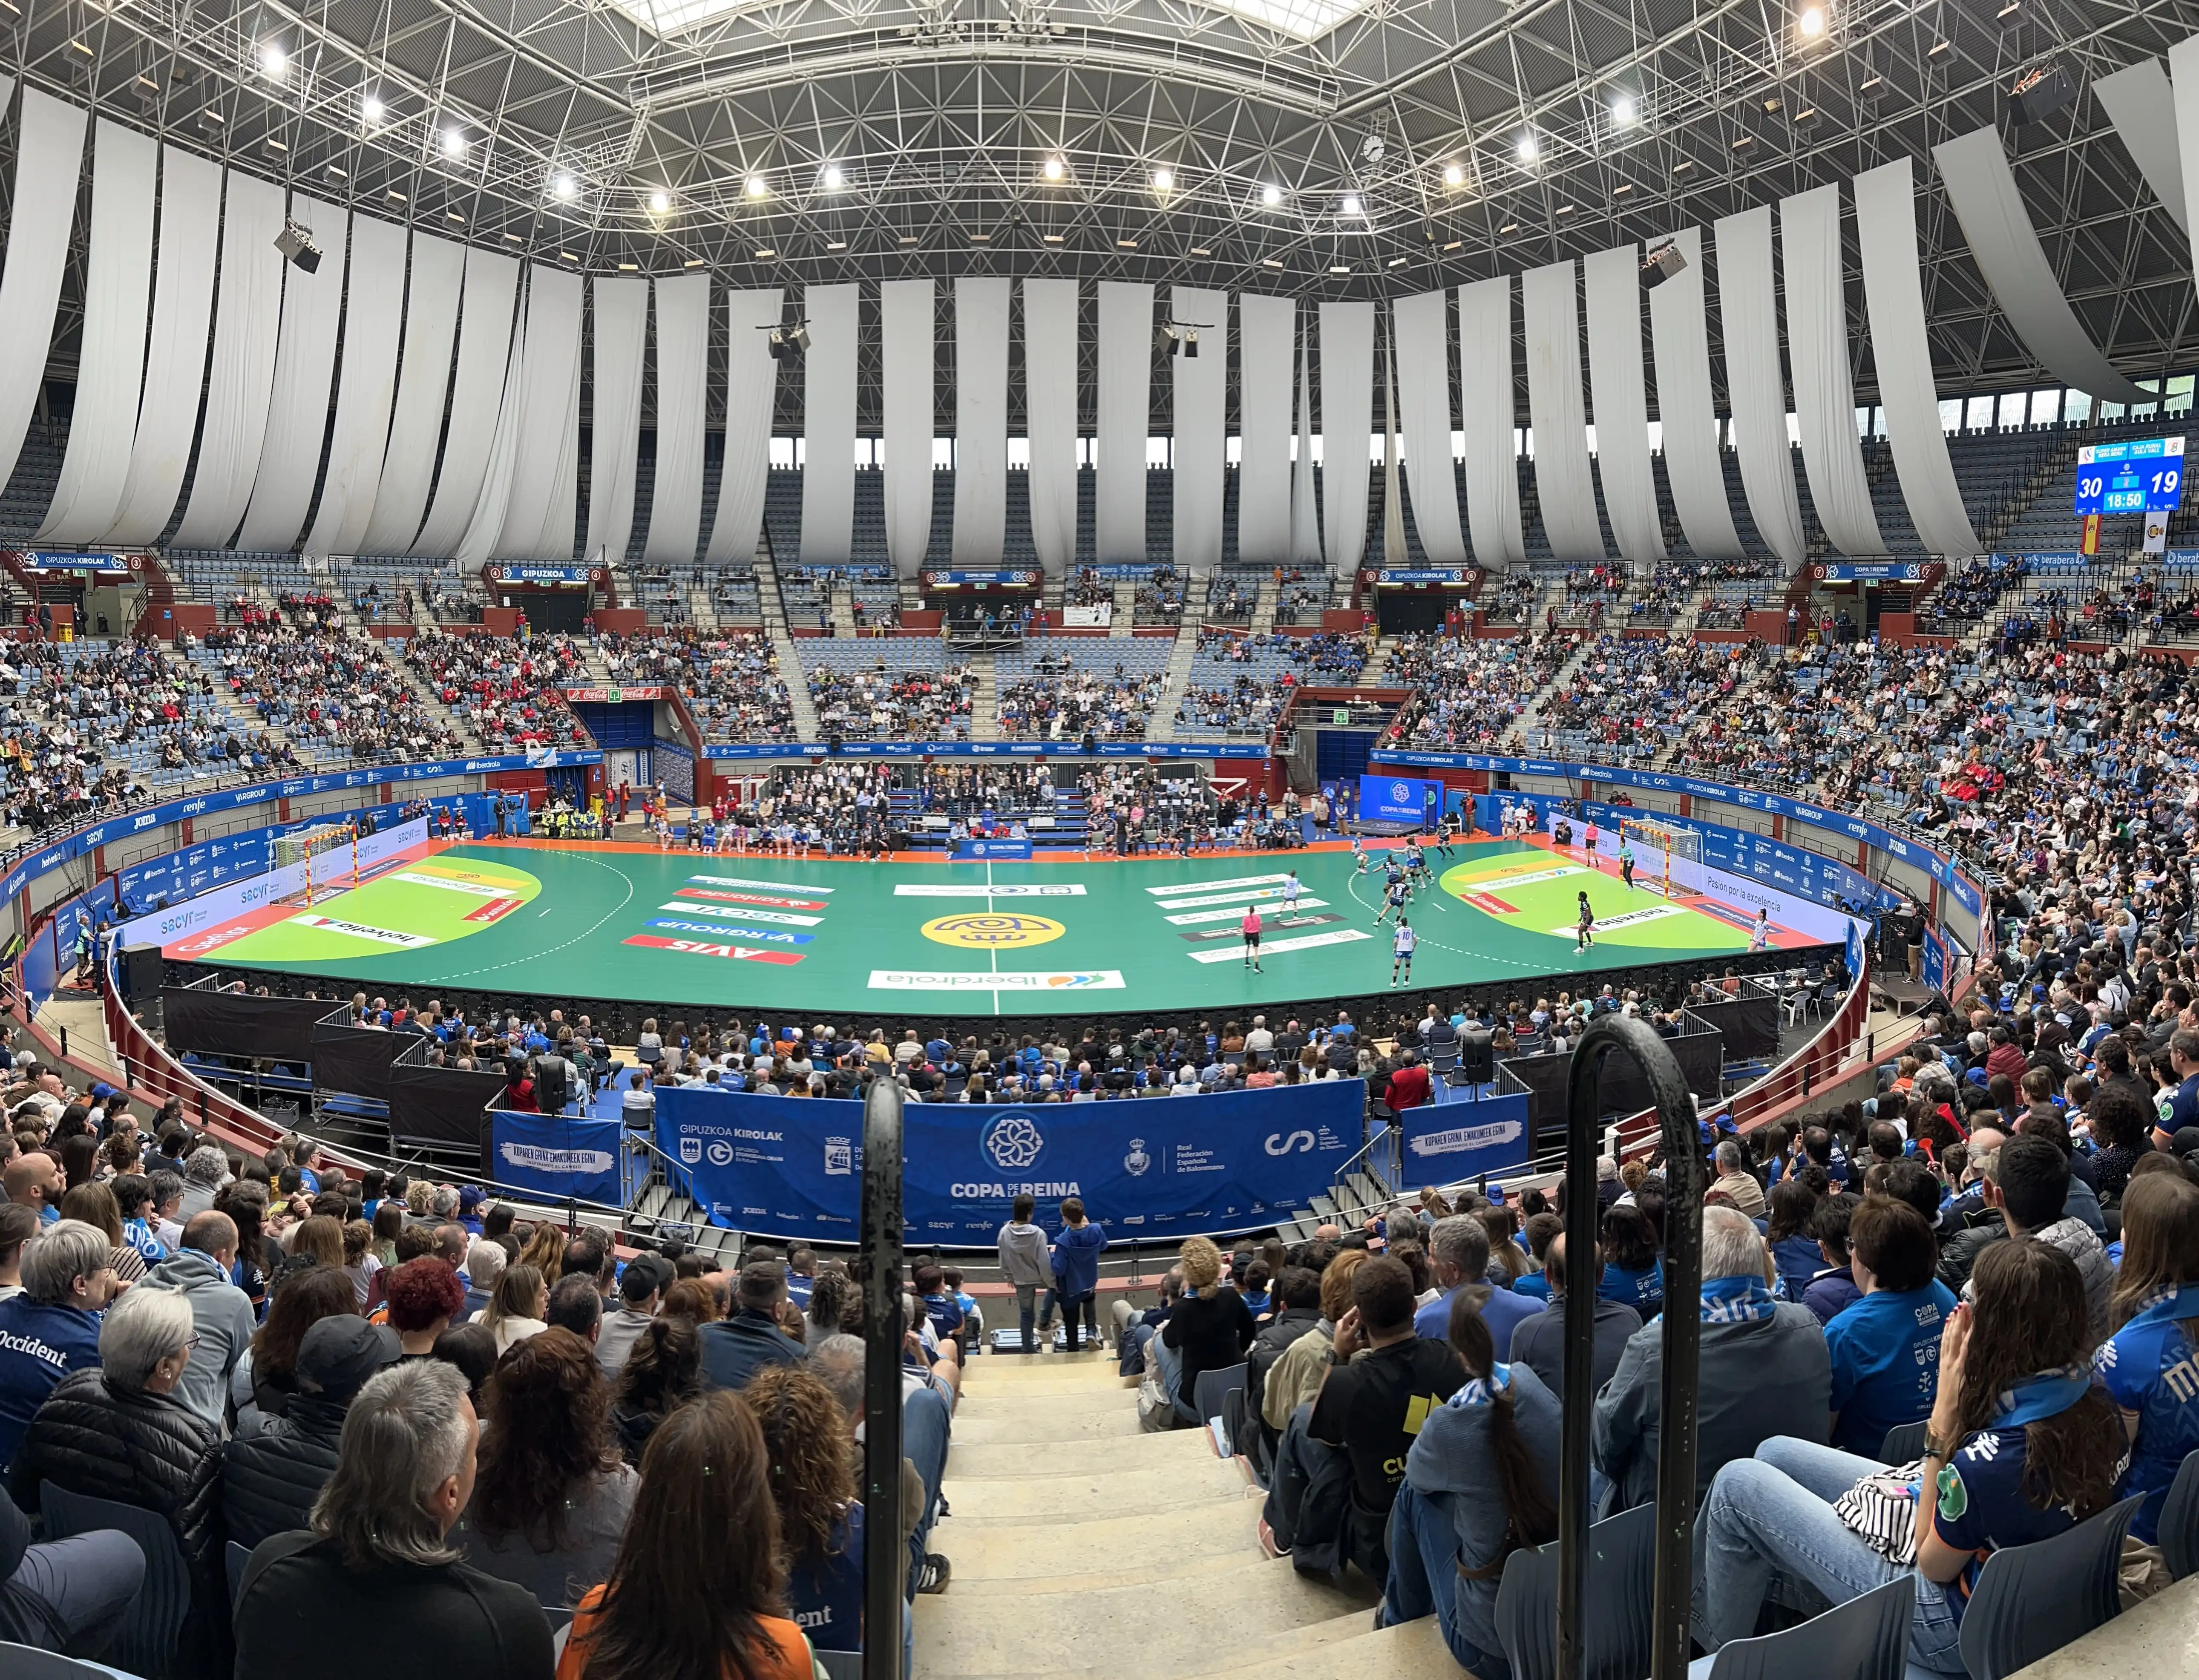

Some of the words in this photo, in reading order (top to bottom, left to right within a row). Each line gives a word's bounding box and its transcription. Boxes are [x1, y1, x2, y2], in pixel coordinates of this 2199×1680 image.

[2079, 478, 2102, 498] 30
[2151, 471, 2178, 493] 19
[2107, 493, 2141, 508] 18:50
[2177, 552, 2199, 564] berab
[1590, 769, 1612, 778] Iberdrola
[235, 788, 266, 803] VARGROUP
[1687, 783, 1707, 792] GIPUZKOA
[1707, 788, 1727, 797] KIROLAK
[183, 798, 205, 813] renfe
[1795, 806, 1823, 820] VARGROUP
[86, 828, 104, 846] sacyr
[398, 829, 414, 843] sacyr
[1848, 823, 1867, 837] renfe
[42, 852, 60, 869] helvetia
[1932, 858, 1943, 877] sacyr
[12, 871, 26, 891] Santander
[1163, 884, 1207, 892] amara
[242, 883, 268, 903] sacyr
[692, 890, 787, 904] Santander
[1181, 892, 1258, 905] Iberdrola
[1397, 887, 1402, 895] 8
[1708, 876, 1727, 892] Pasión
[1729, 887, 1738, 898] por
[1740, 889, 1745, 898] la
[1747, 892, 1780, 912] excelencia
[1954, 881, 1967, 901] helvetia
[482, 899, 517, 917] Santander
[1476, 896, 1508, 913] Santander
[686, 907, 794, 921] sacyr
[1594, 909, 1670, 926] helvetia
[1716, 908, 1757, 926] SPAGNOL
[161, 911, 193, 934] sacyr
[177, 926, 254, 951] Gerflor
[337, 923, 417, 942] helvetia
[656, 921, 796, 943] VARGROUP
[1403, 932, 1410, 940] 10
[665, 940, 768, 958] AVIS
[887, 975, 1037, 985] Iberdrola
[680, 1124, 732, 1136] GIPUZKOA
[734, 1128, 783, 1142] KIROLAK
[1425, 1135, 1447, 1147] KOPAREN
[1448, 1132, 1462, 1143] GRINA
[1464, 1127, 1492, 1142] EMAKUMEEK
[1493, 1125, 1505, 1136] EGINA
[514, 1146, 534, 1159] KOPAREN
[535, 1150, 548, 1162] GRINA
[550, 1152, 580, 1164] EMAKUMEEK
[581, 1153, 596, 1165] EGINA
[1177, 1150, 1213, 1158] Federación
[1177, 1158, 1207, 1166] Española
[527, 1160, 554, 1169] INSPIRAMOS
[1187, 1164, 1225, 1172] Balonmano
[951, 1183, 1006, 1198] COPA
[1020, 1182, 1081, 1197] REINA
[965, 1220, 993, 1231] renfe
[1914, 1303, 1938, 1318] COPA
[0, 1330, 67, 1368] Occident
